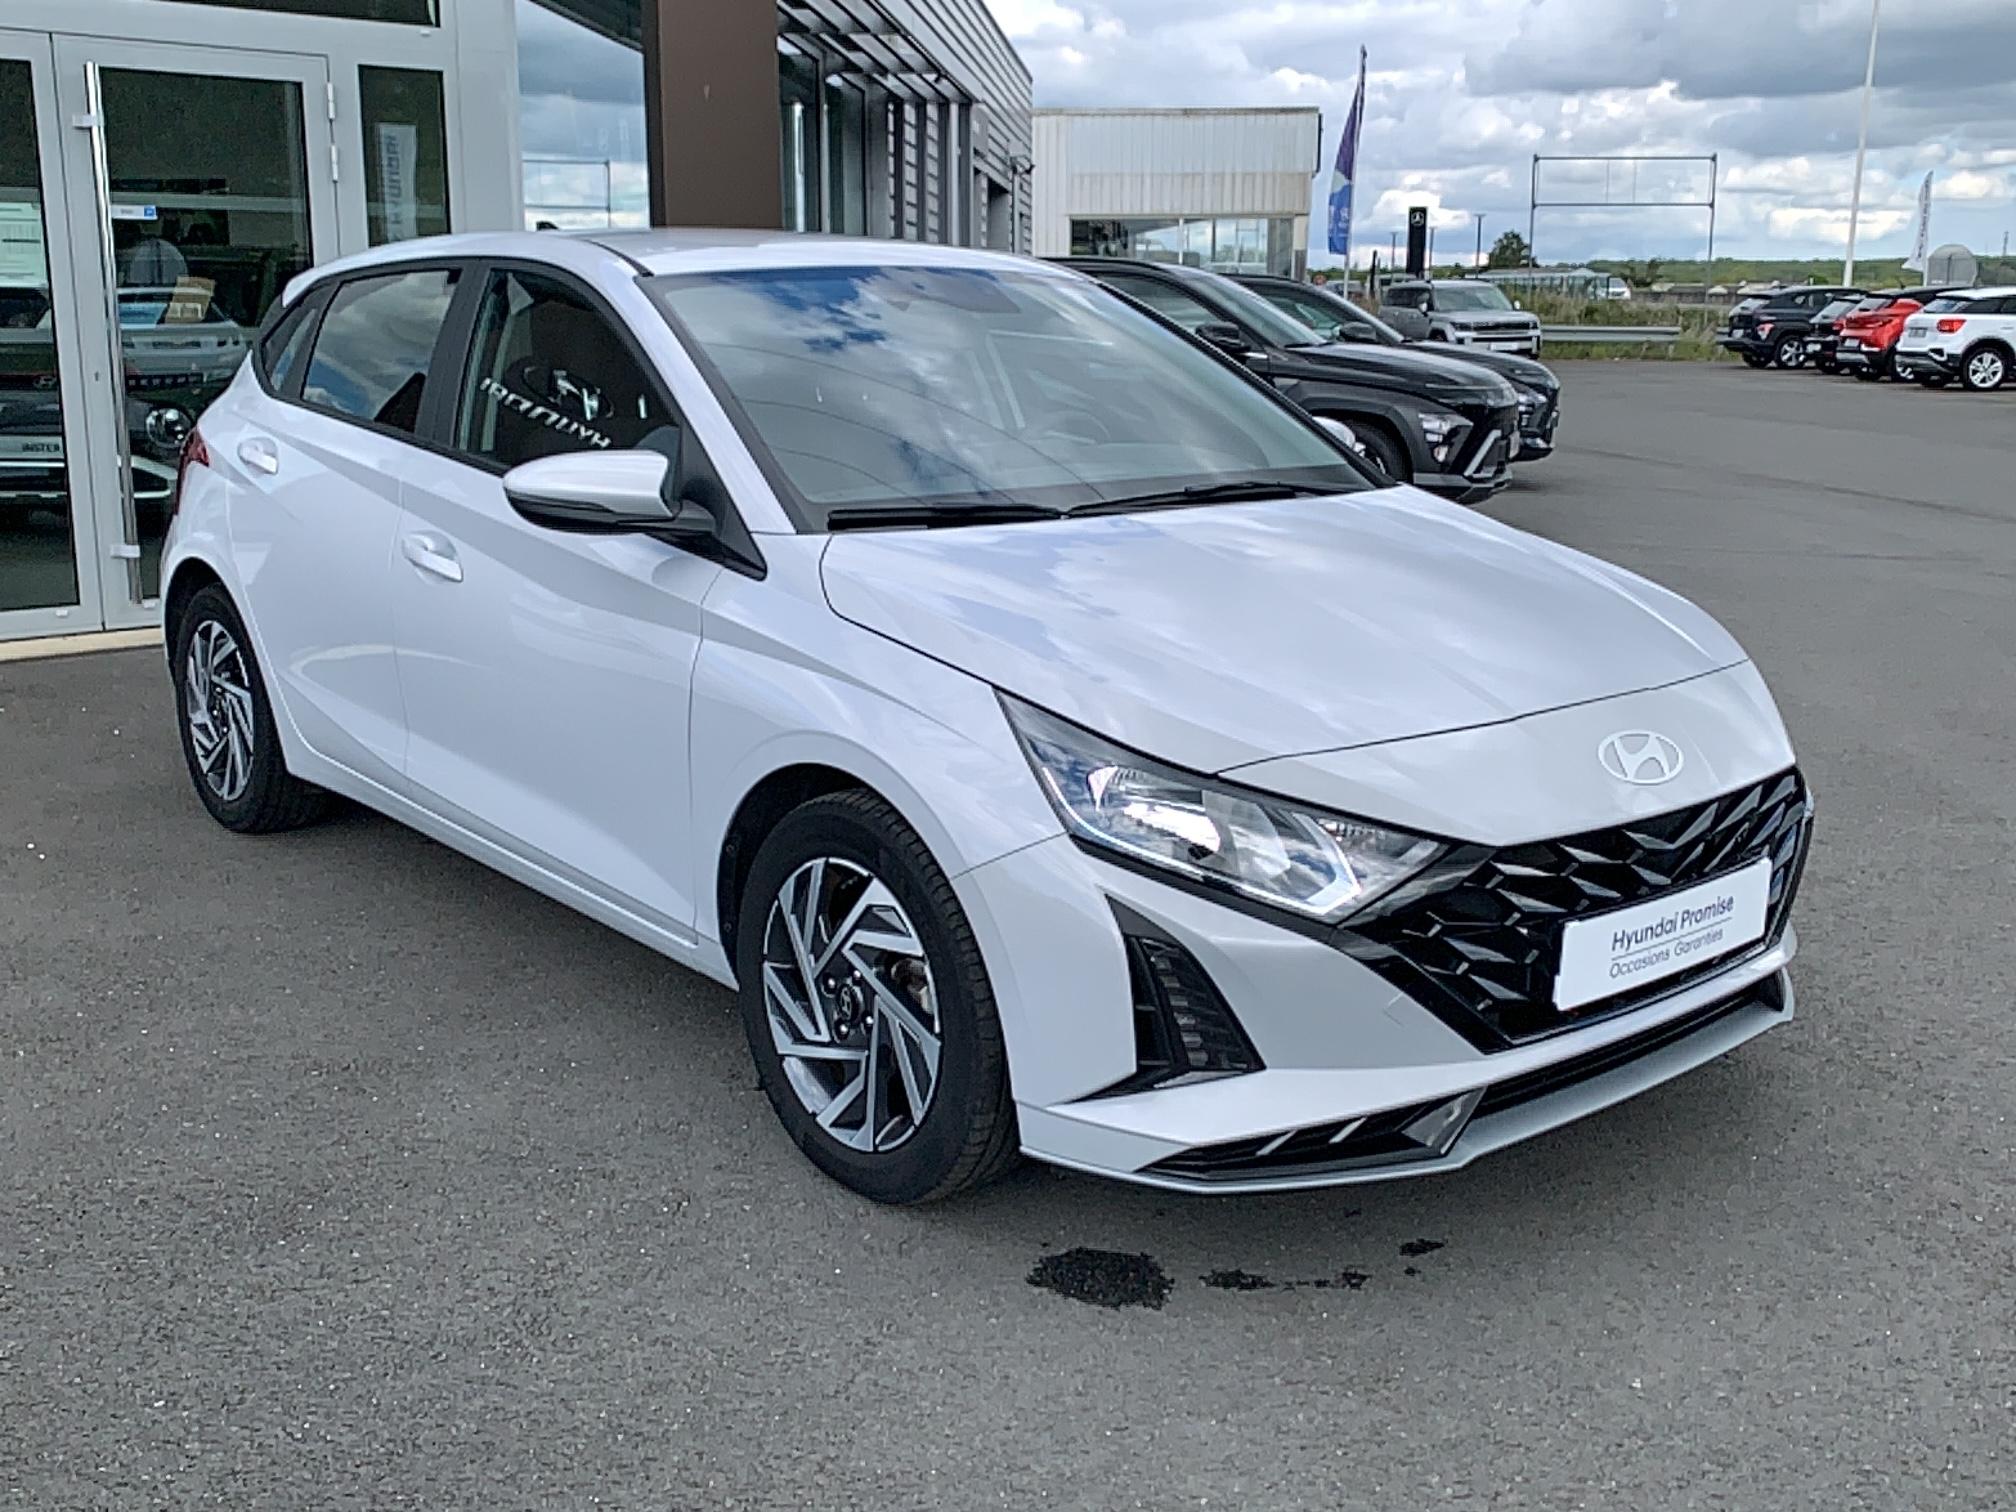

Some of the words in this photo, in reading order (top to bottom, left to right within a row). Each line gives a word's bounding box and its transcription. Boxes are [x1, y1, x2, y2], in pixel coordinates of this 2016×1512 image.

[1611, 911, 1679, 952] Hyundai
[1680, 895, 1734, 930] Promise
[1609, 948, 1670, 979] Occasions
[1673, 927, 1724, 957] Garanties
